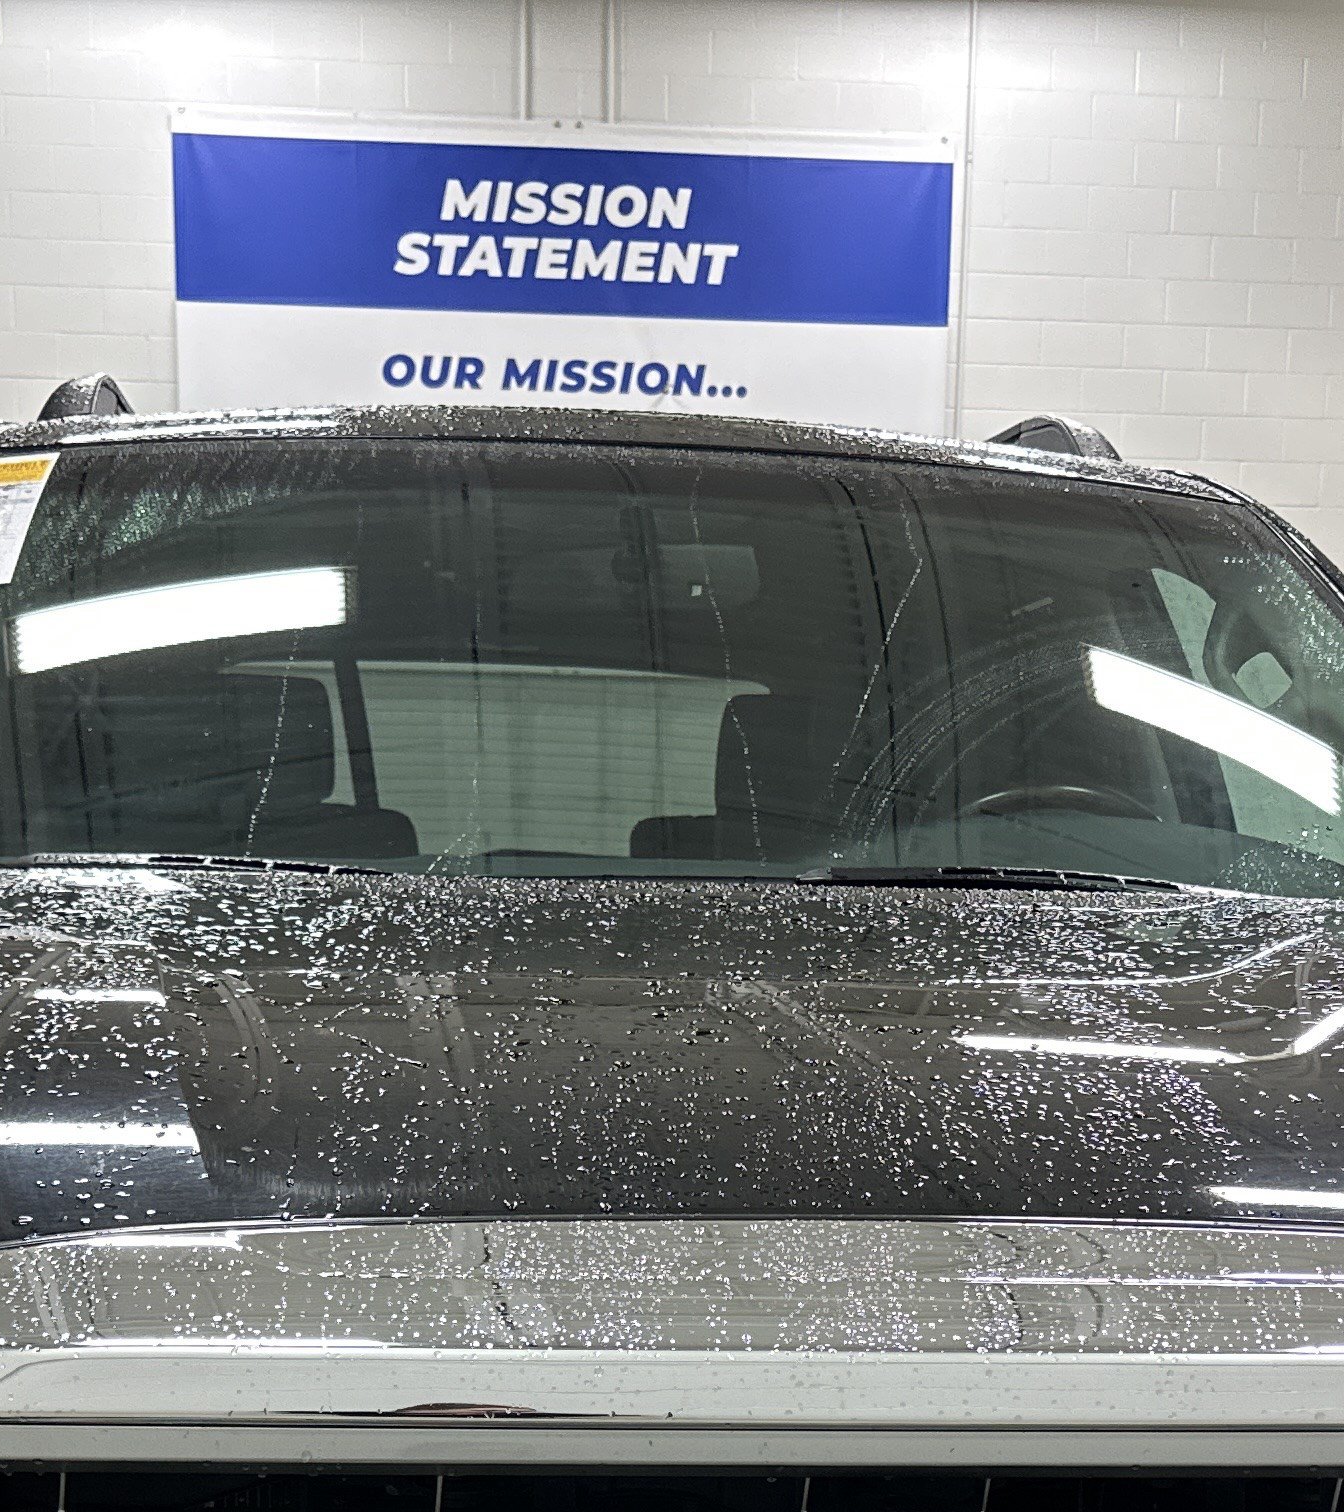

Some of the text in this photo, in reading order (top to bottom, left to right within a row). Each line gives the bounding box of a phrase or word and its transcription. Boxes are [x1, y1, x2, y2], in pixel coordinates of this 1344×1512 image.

[439, 179, 693, 230] MISSION
[393, 231, 740, 286] STATEMENT
[382, 353, 748, 398] OUR MISSION...
